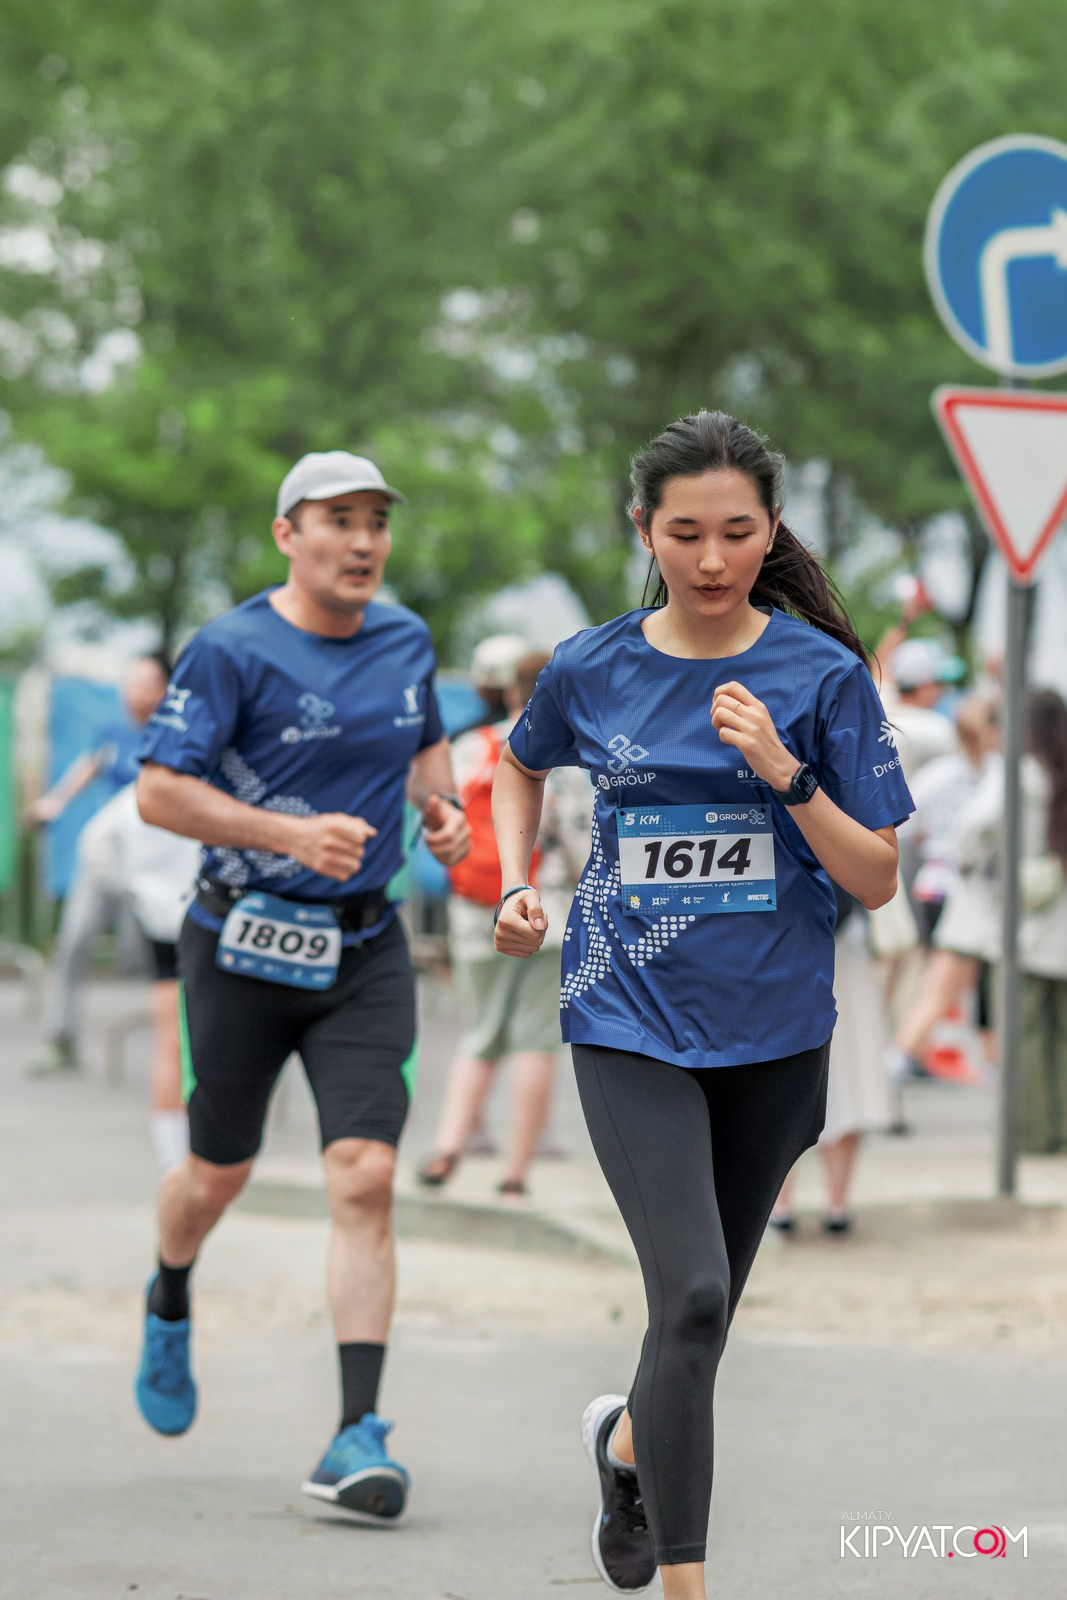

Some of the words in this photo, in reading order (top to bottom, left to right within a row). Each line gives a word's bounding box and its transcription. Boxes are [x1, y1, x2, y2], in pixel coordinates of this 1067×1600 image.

[609, 772, 656, 787] GROUP
[737, 769, 748, 778] BI
[624, 813, 636, 826] 5
[639, 814, 660, 825] KM
[719, 813, 748, 821] GROUP
[644, 838, 752, 879] 1614
[238, 920, 329, 960] 1809
